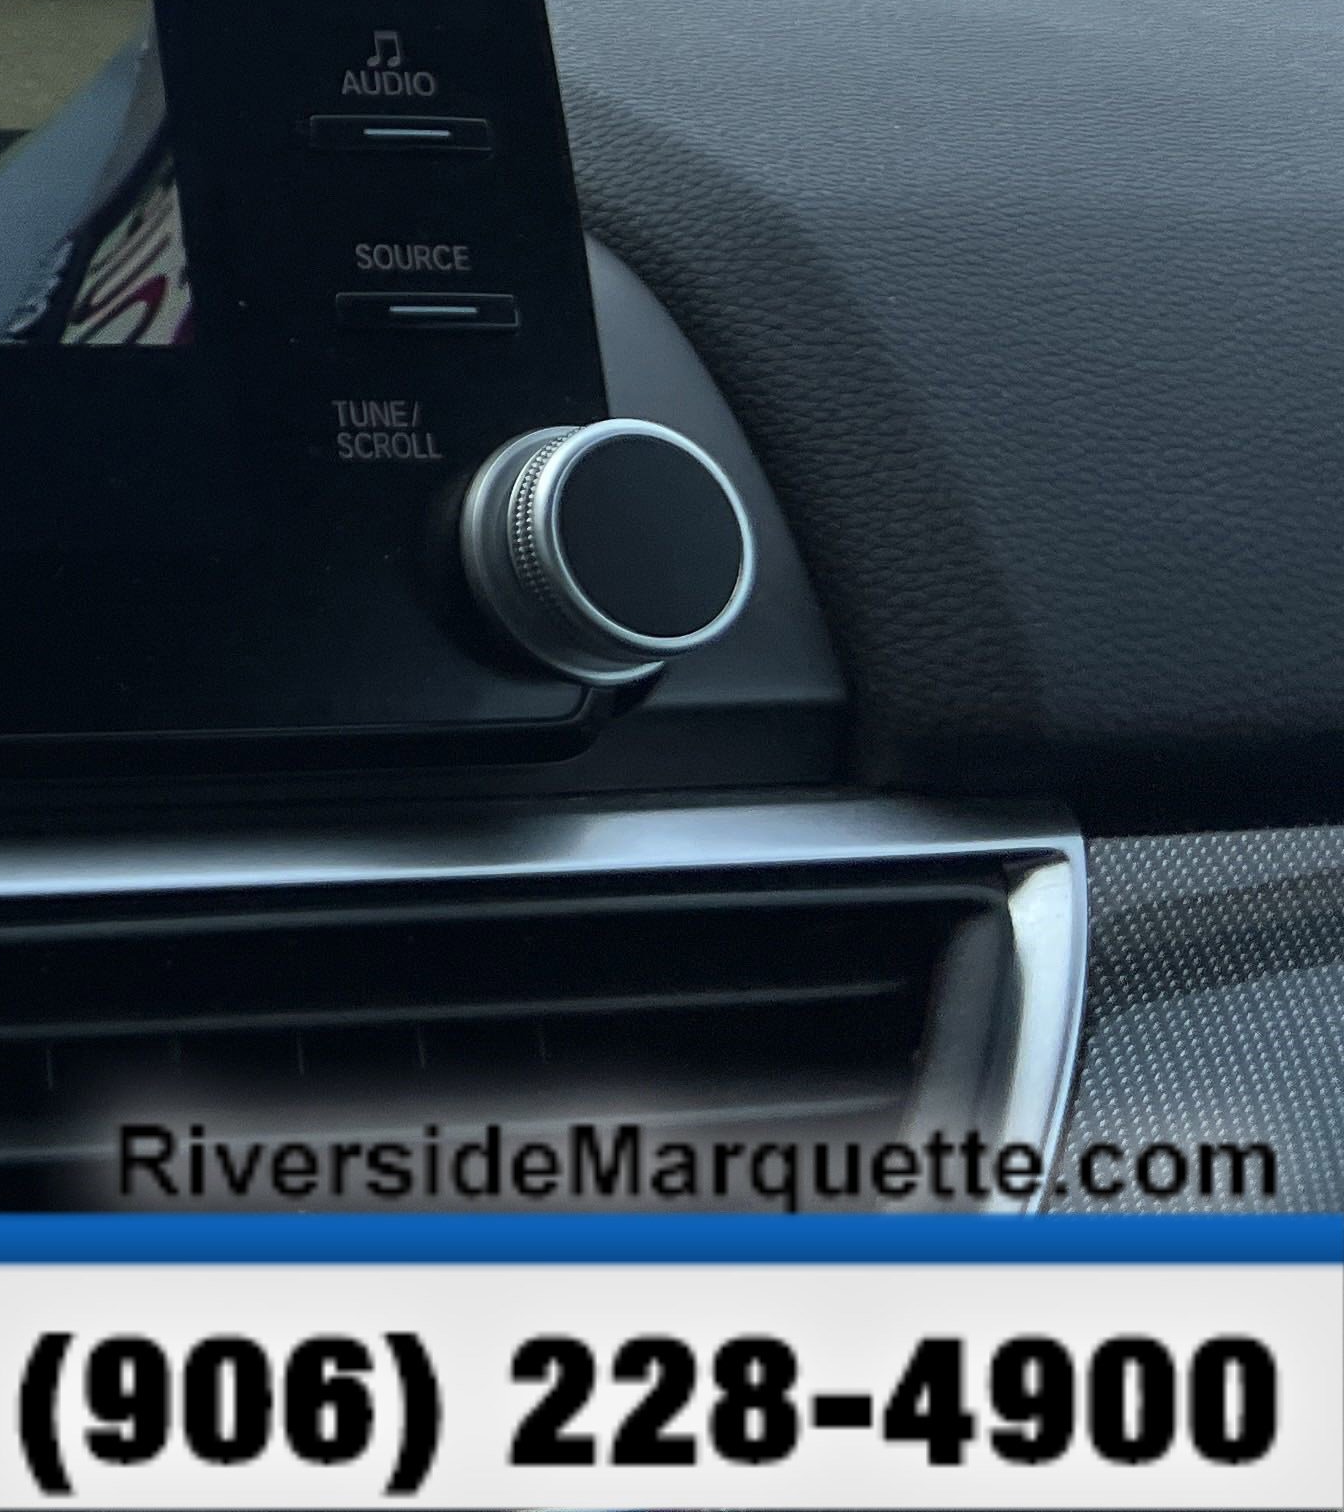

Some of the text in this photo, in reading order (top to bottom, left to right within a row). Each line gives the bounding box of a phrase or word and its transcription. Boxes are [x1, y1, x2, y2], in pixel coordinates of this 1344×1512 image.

[341, 71, 437, 97] AUDIO
[355, 243, 472, 272] SOURCE
[332, 400, 420, 428] TUNE/
[336, 432, 444, 460] SCROLL
